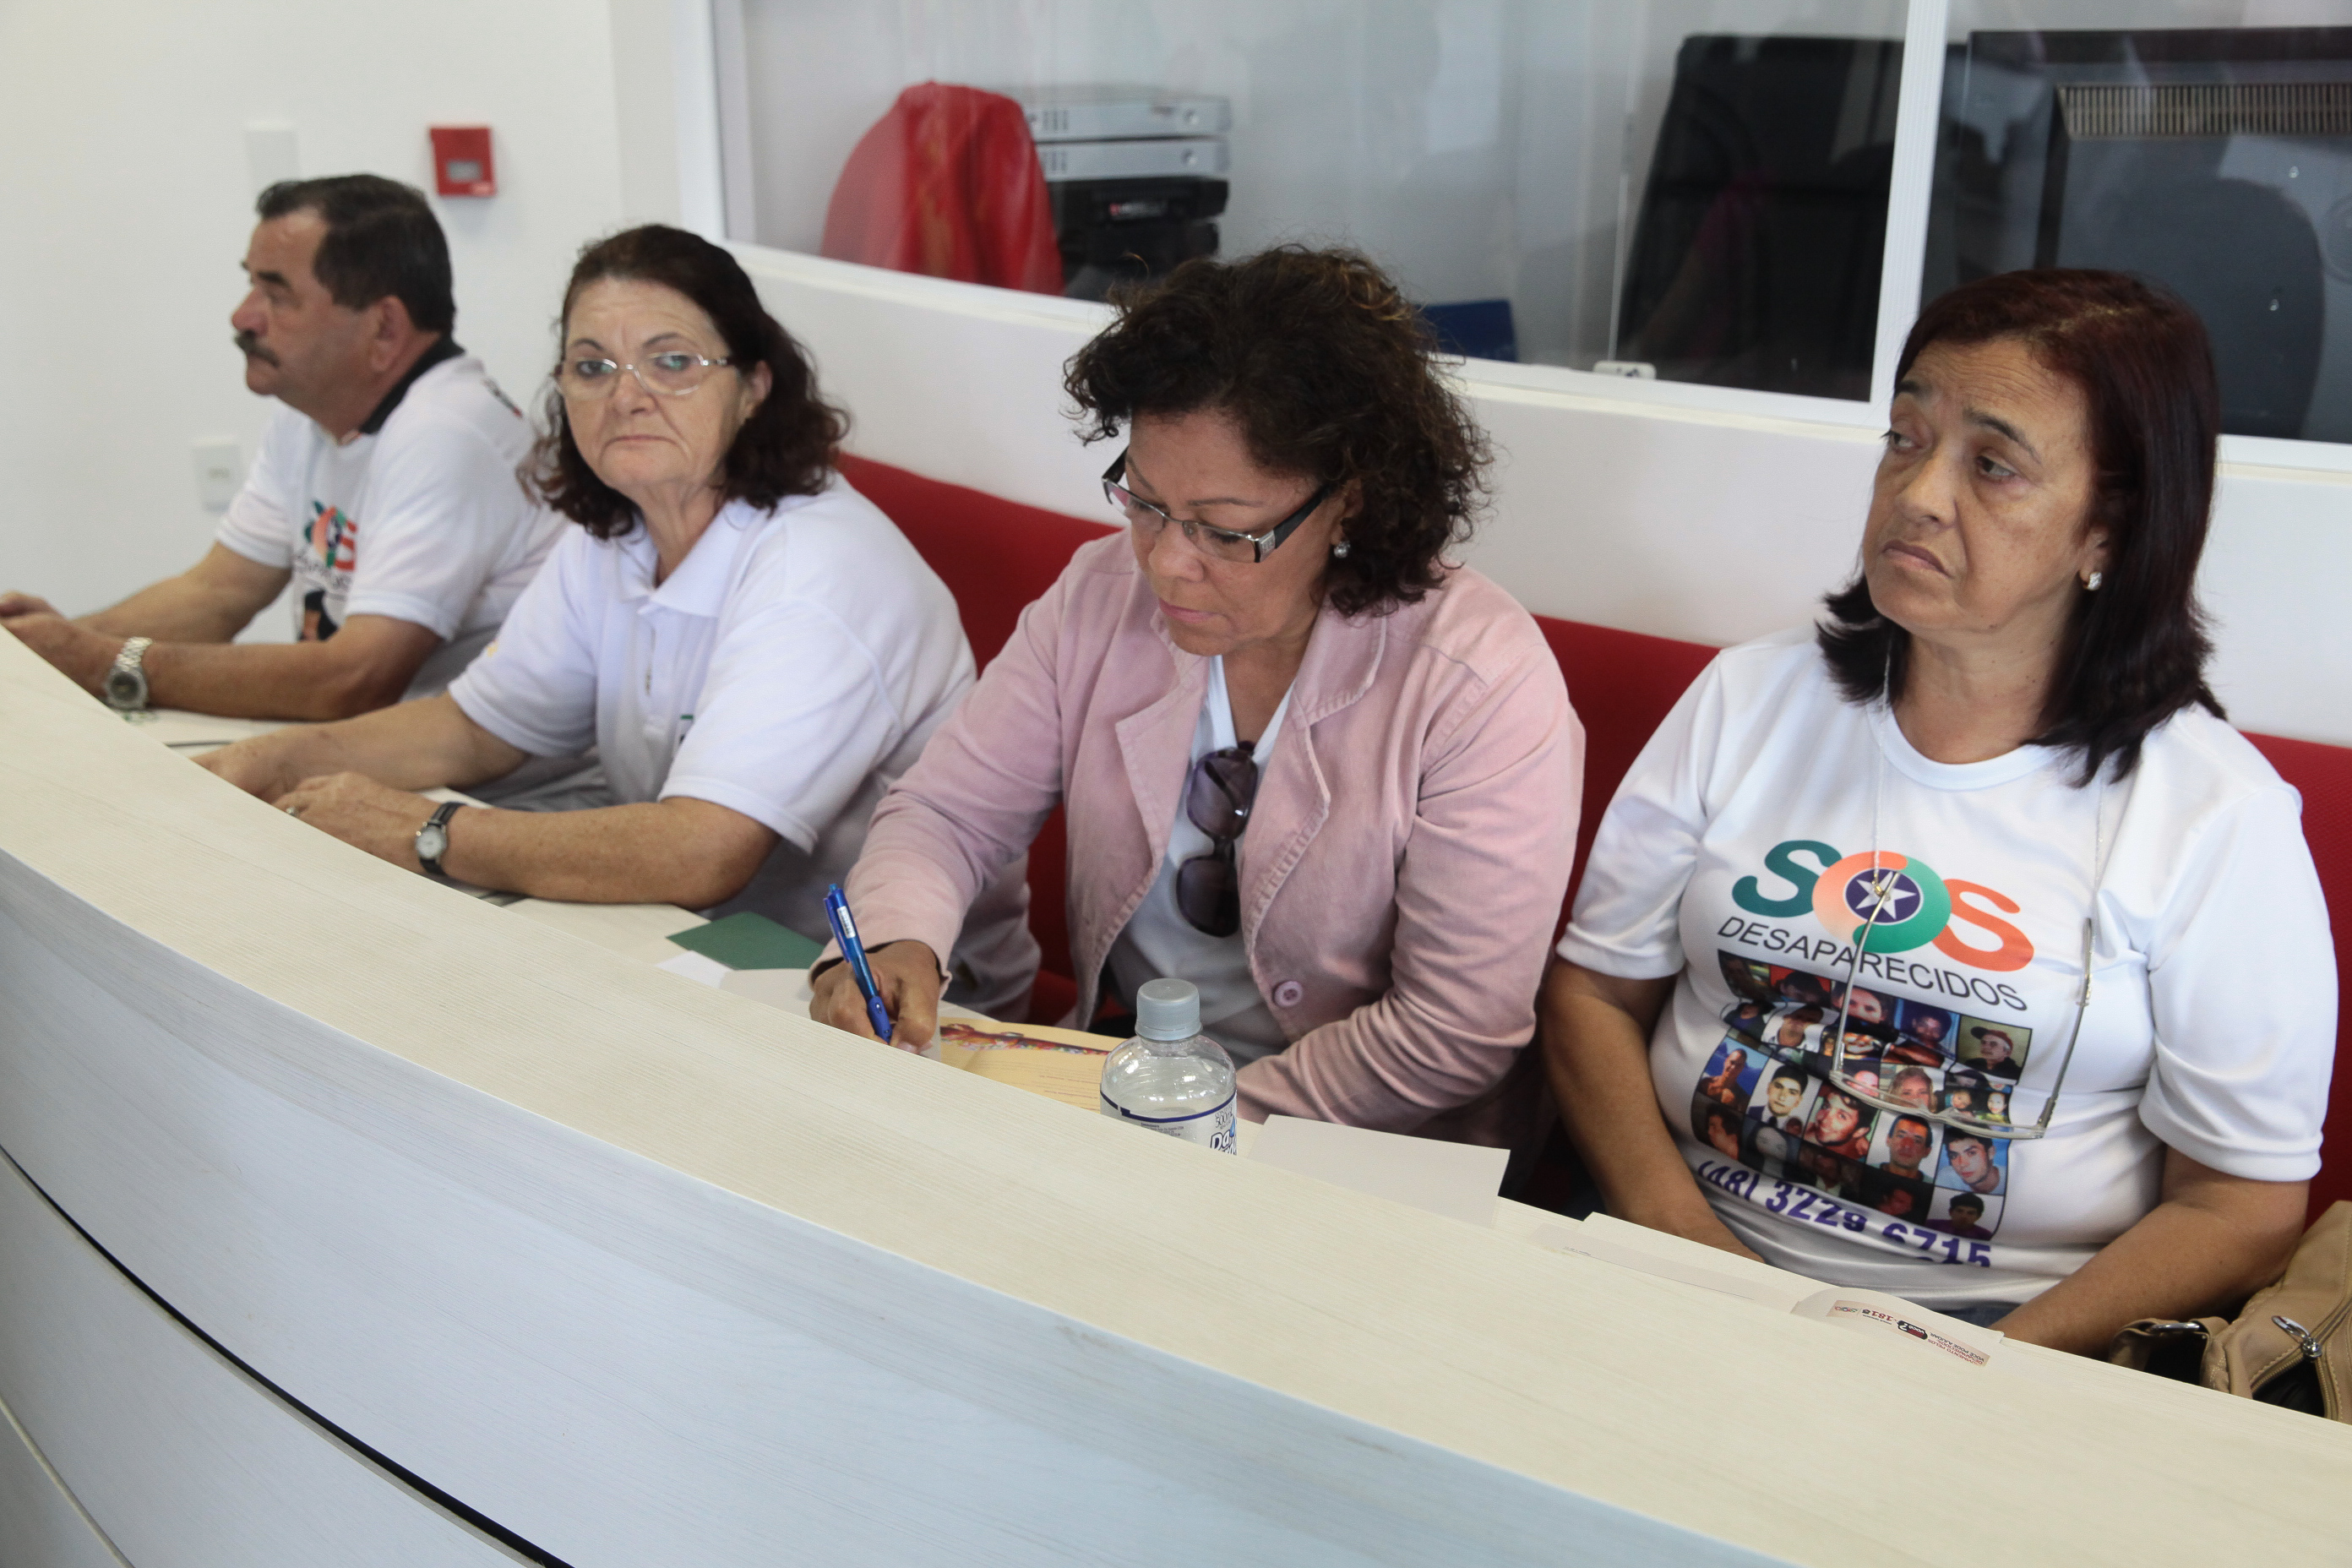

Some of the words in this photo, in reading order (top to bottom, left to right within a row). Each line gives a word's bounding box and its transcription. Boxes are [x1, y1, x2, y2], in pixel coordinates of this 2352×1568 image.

[1731, 839, 2035, 972] SOS
[1717, 916, 2028, 1012] DESAPARECIDOS
[1765, 1180, 1868, 1233] 3229
